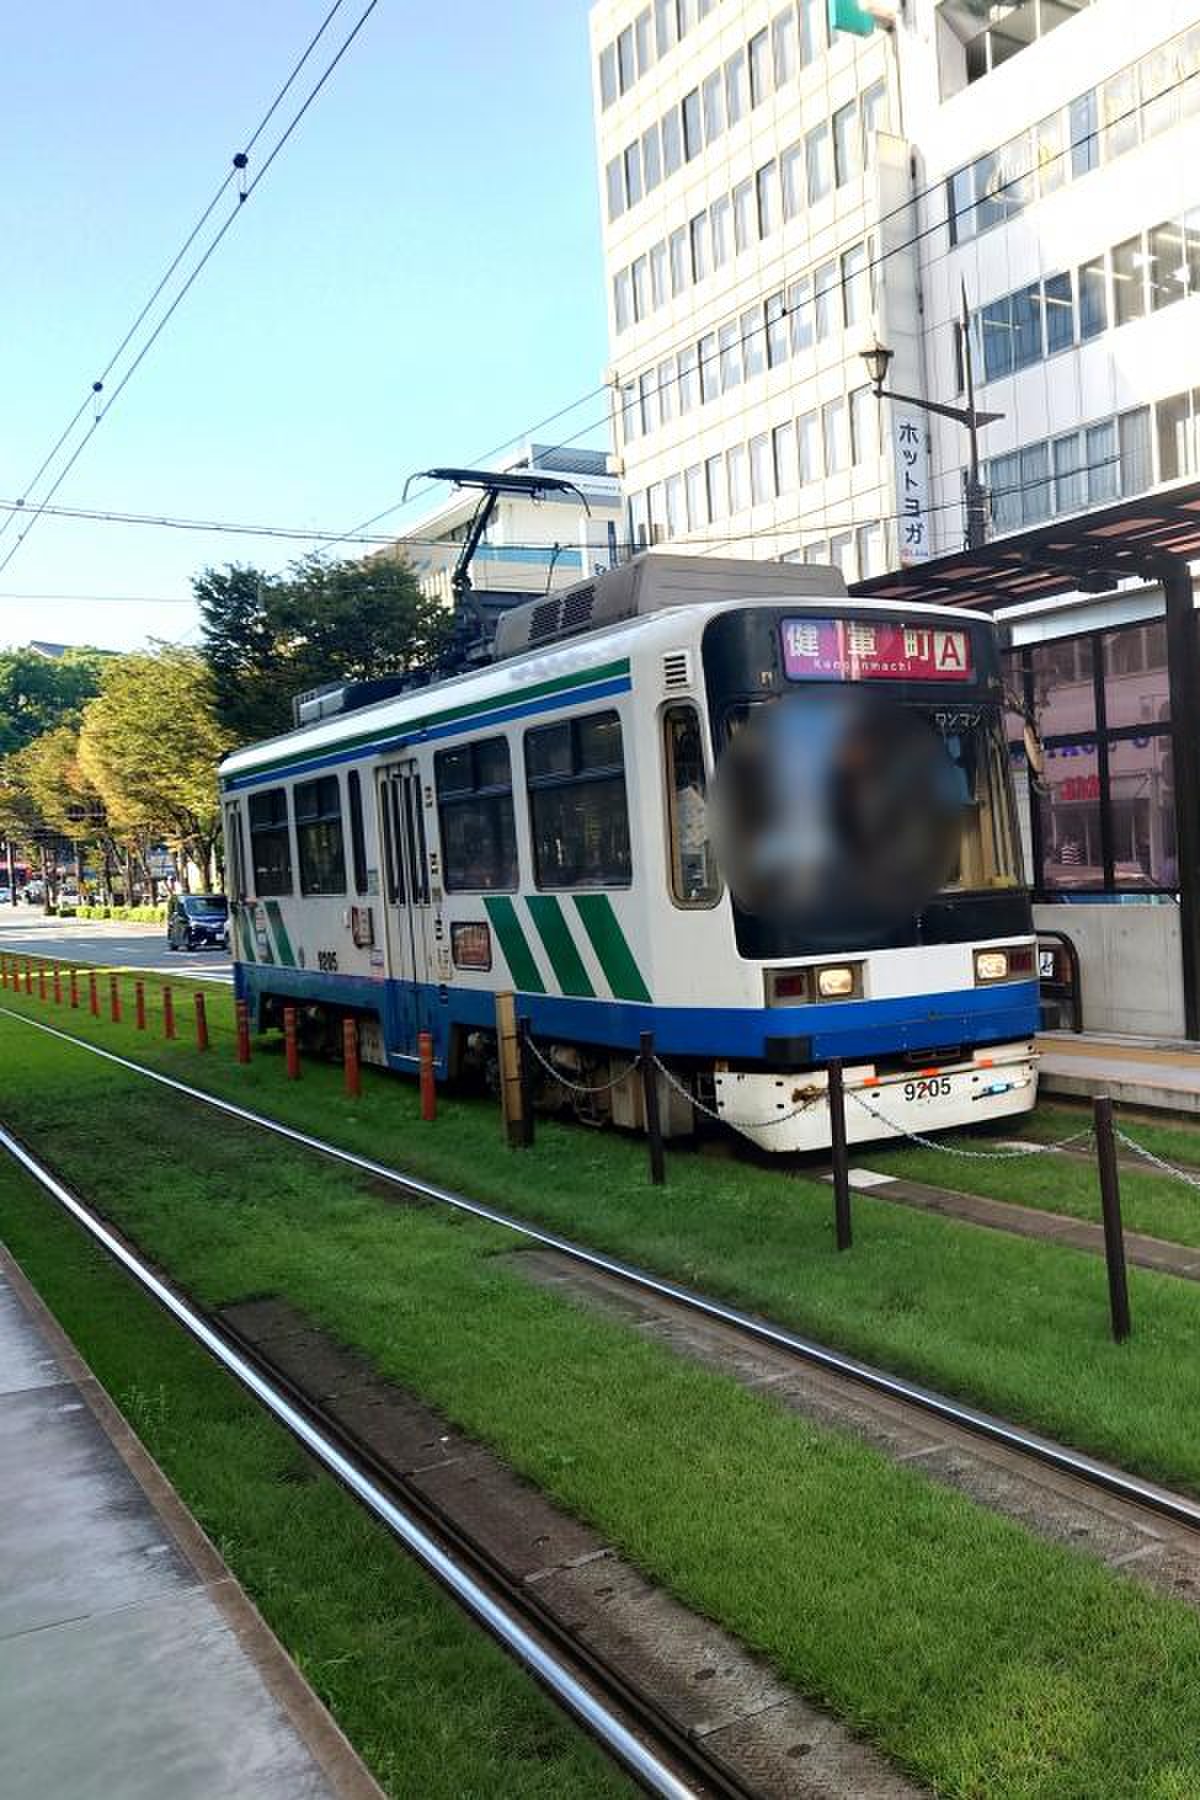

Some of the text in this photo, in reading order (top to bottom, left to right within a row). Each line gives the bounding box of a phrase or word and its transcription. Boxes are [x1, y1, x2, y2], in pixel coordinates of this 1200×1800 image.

[899, 422, 925, 545] ホットヨガ
[904, 1077, 951, 1102] 9205
